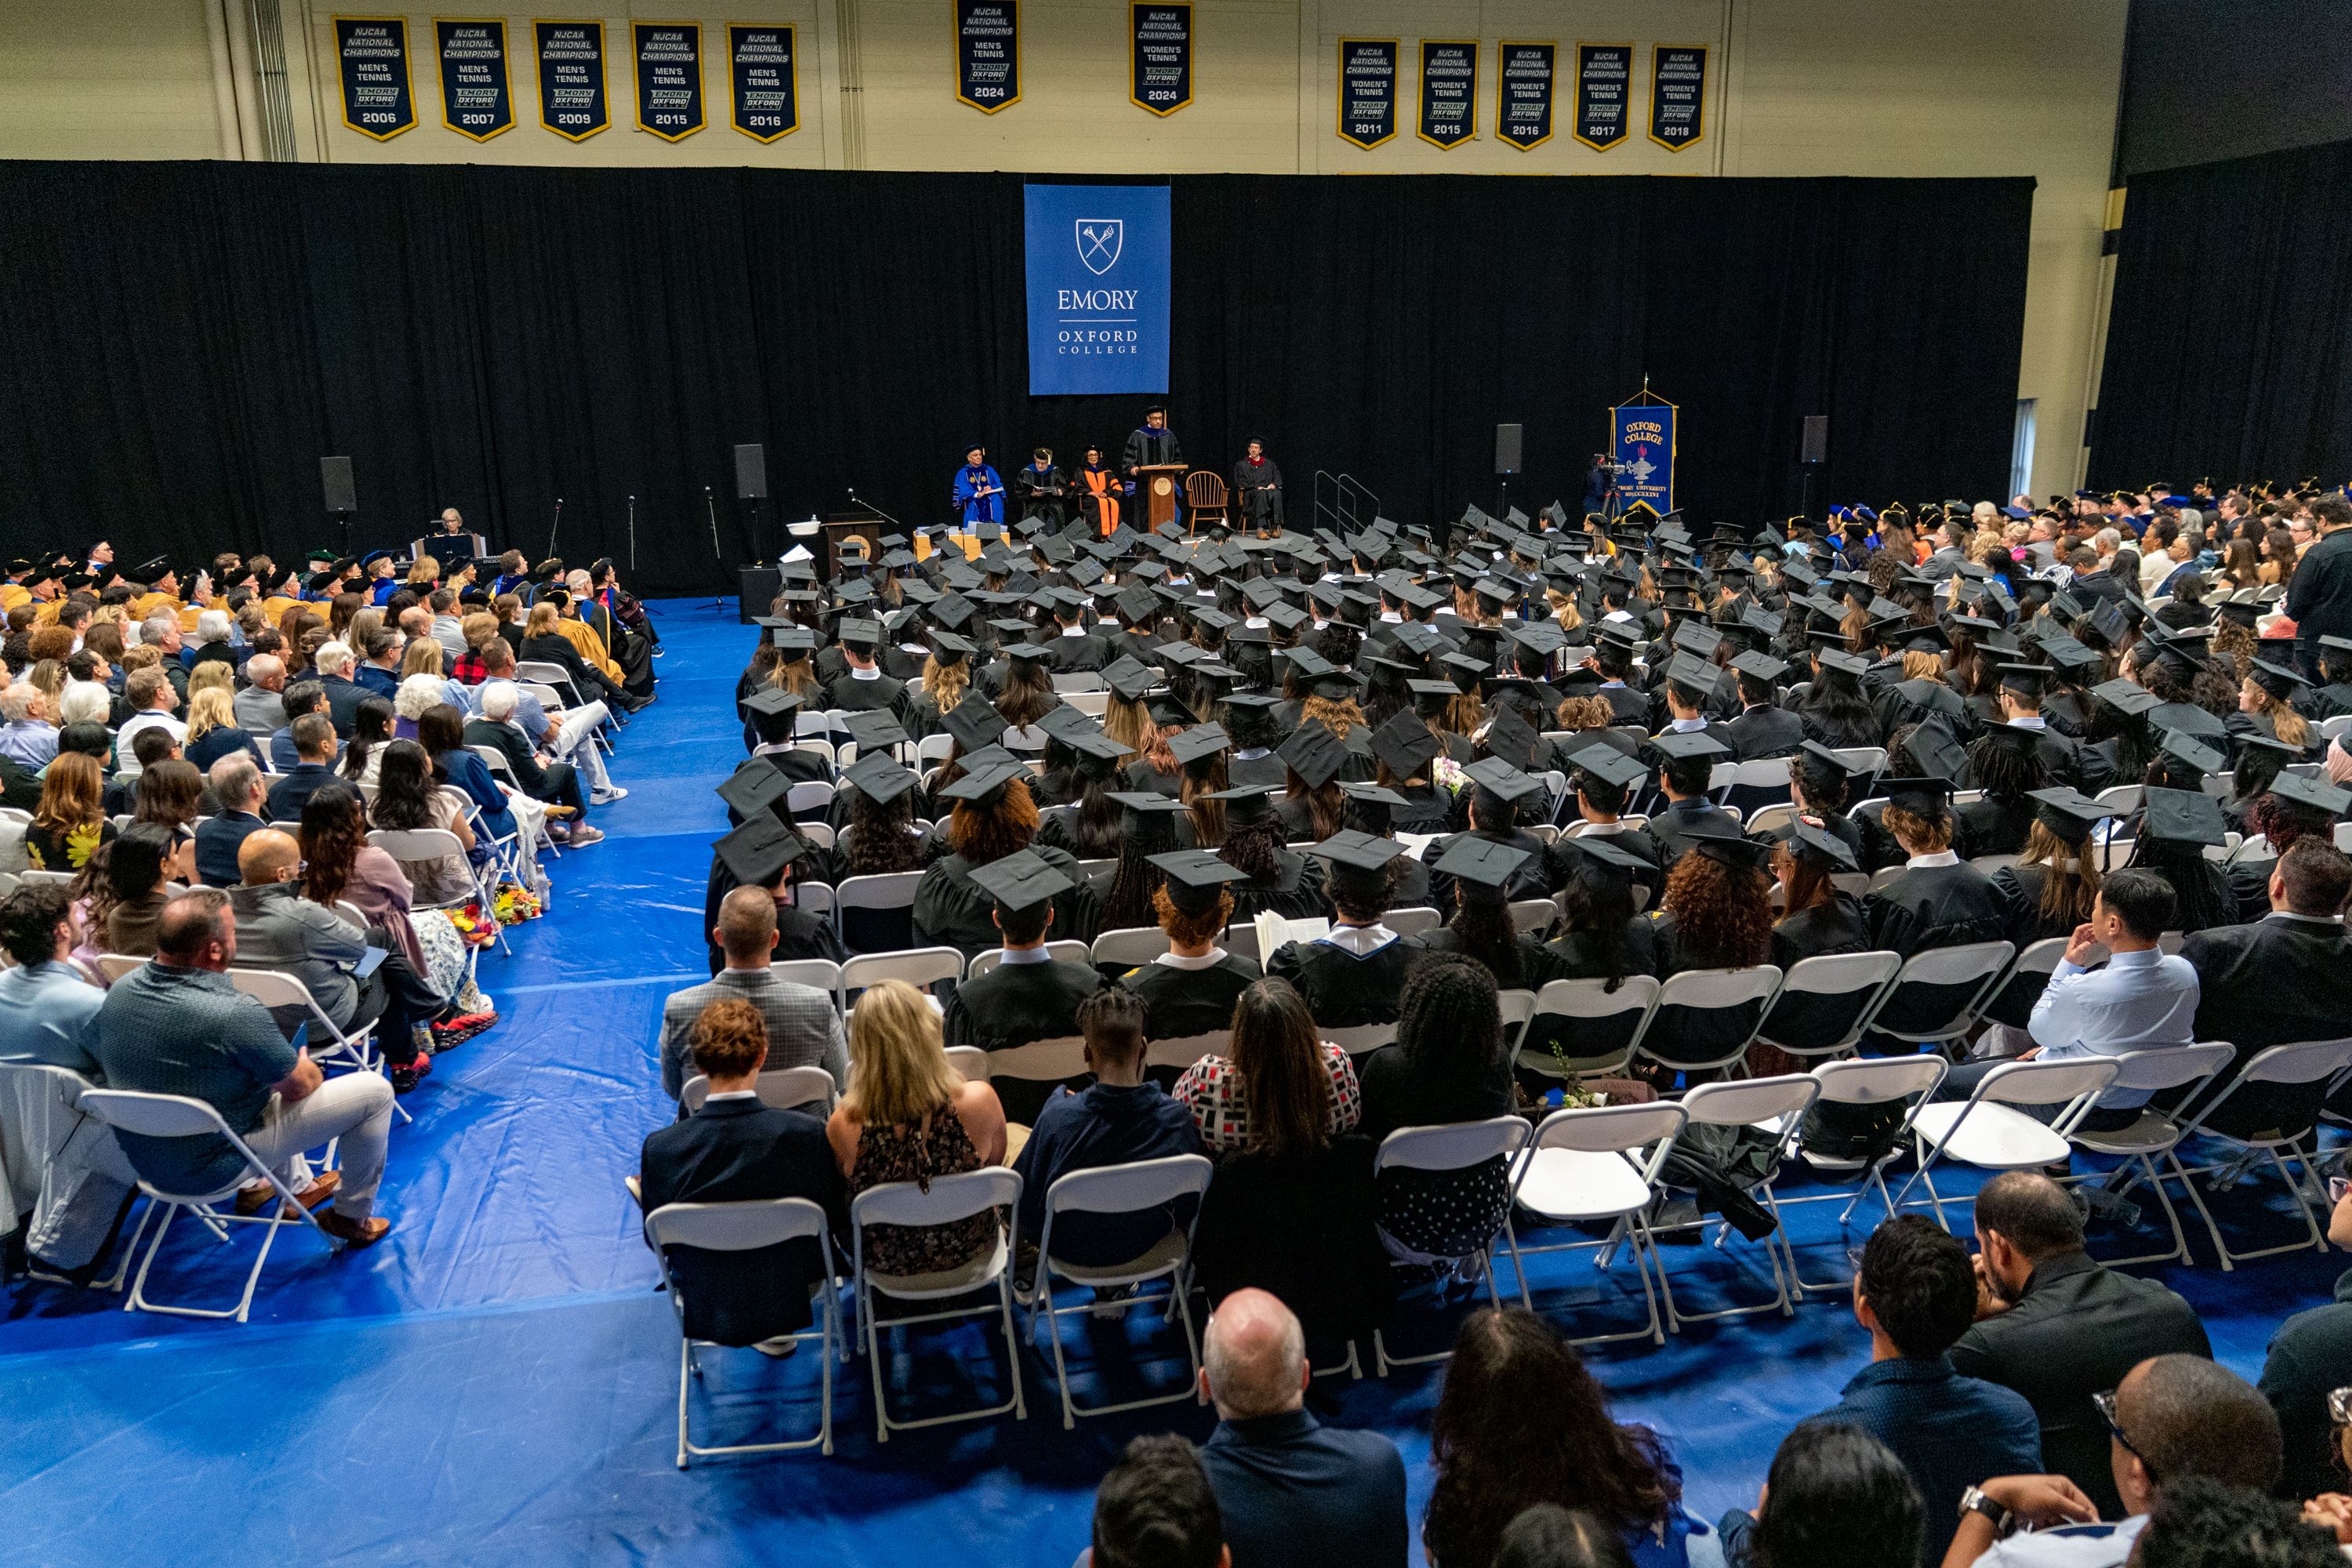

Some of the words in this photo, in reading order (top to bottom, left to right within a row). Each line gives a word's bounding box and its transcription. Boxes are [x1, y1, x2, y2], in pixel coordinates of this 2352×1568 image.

[975, 88, 1004, 97] 2024
[1149, 91, 1177, 100] 2024
[363, 113, 397, 122] 2006
[463, 114, 494, 124] 2007
[558, 114, 590, 124] 2009
[655, 114, 687, 124] 2015
[750, 116, 781, 126] 2016
[1356, 125, 1381, 133] 2011
[1434, 125, 1461, 134] 2015
[1513, 126, 1539, 135] 2016
[1590, 127, 1615, 136] 2017
[1664, 127, 1689, 136] 2018
[1058, 290, 1138, 310] EMORY
[1058, 331, 1137, 342] OXFORD
[1626, 422, 1661, 432] OXFORD
[1624, 432, 1663, 445] COLLEGE
